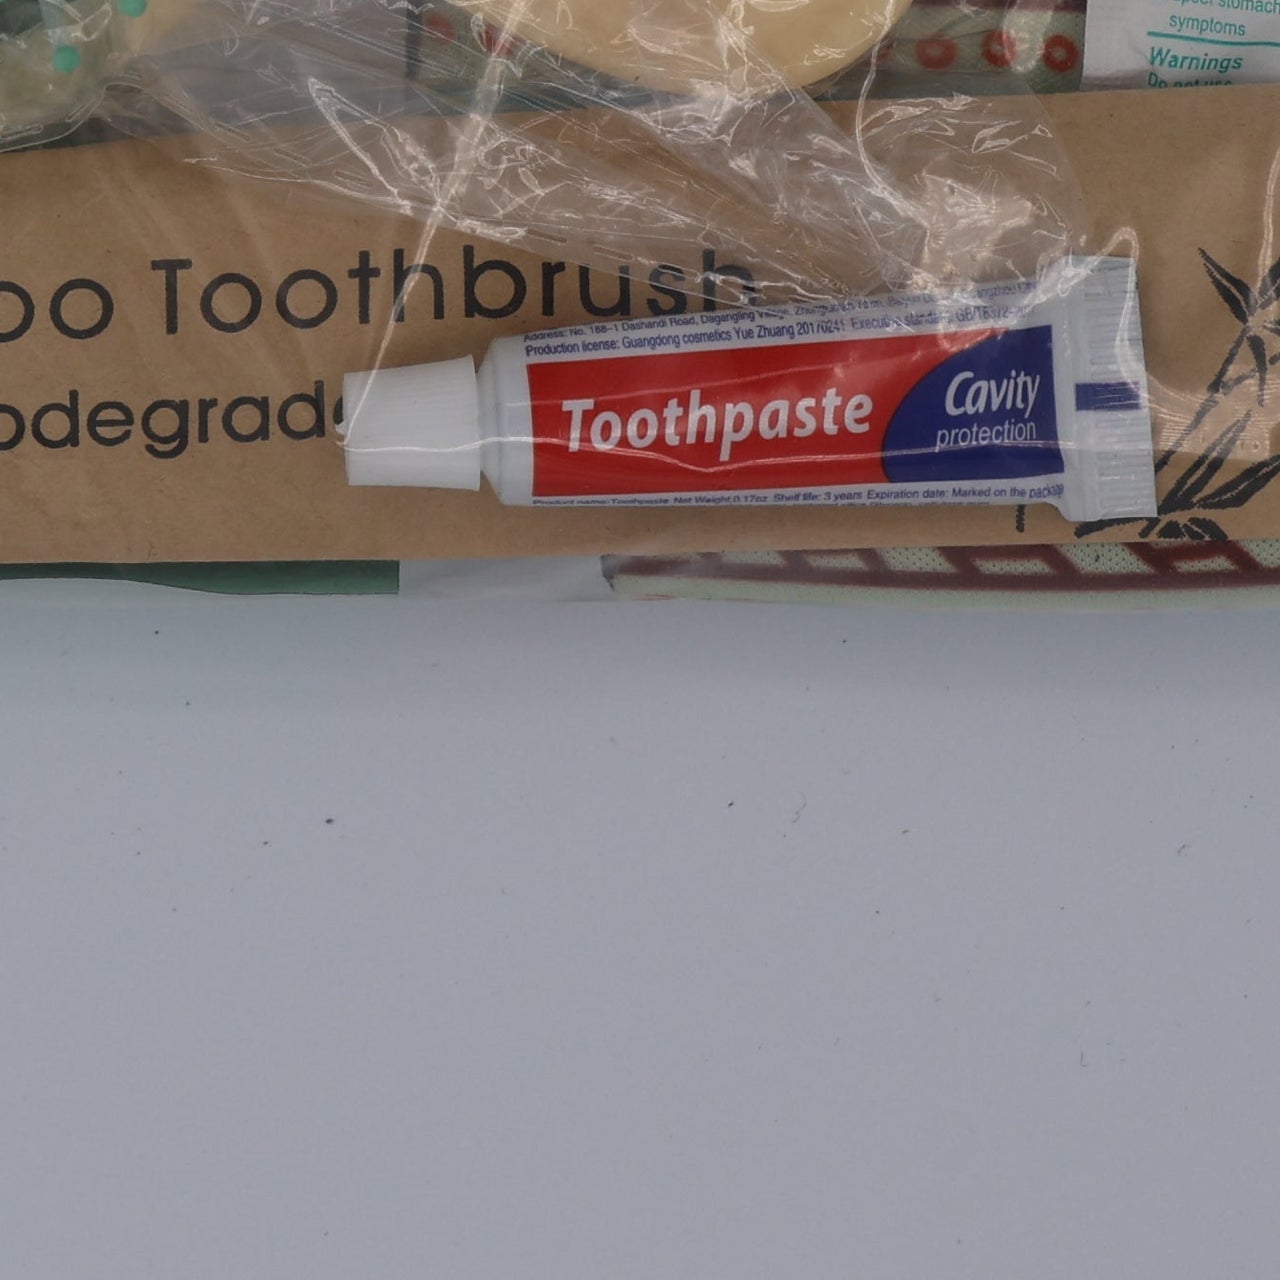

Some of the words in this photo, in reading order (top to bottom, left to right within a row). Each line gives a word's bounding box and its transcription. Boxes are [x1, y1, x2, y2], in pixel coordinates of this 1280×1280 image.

[1169, 14, 1246, 36] symptoms
[1149, 47, 1243, 73] Warnings
[150, 246, 756, 336] Toothbrush
[525, 343, 580, 356] Production
[582, 339, 620, 352] license:
[622, 332, 680, 350] Guangdong
[683, 329, 731, 344] cosmetics
[734, 327, 754, 339] Yue
[757, 321, 795, 339] Zhuang
[945, 369, 1040, 418] Cavity
[562, 387, 873, 462] Toothpaste
[935, 418, 1037, 453] protection
[773, 492, 801, 502] Shelf
[832, 491, 863, 503] years
[867, 489, 919, 502] Expiration
[922, 488, 948, 500] date:
[951, 486, 991, 498] Marked
[993, 488, 1007, 497] on
[1010, 486, 1026, 497] the
